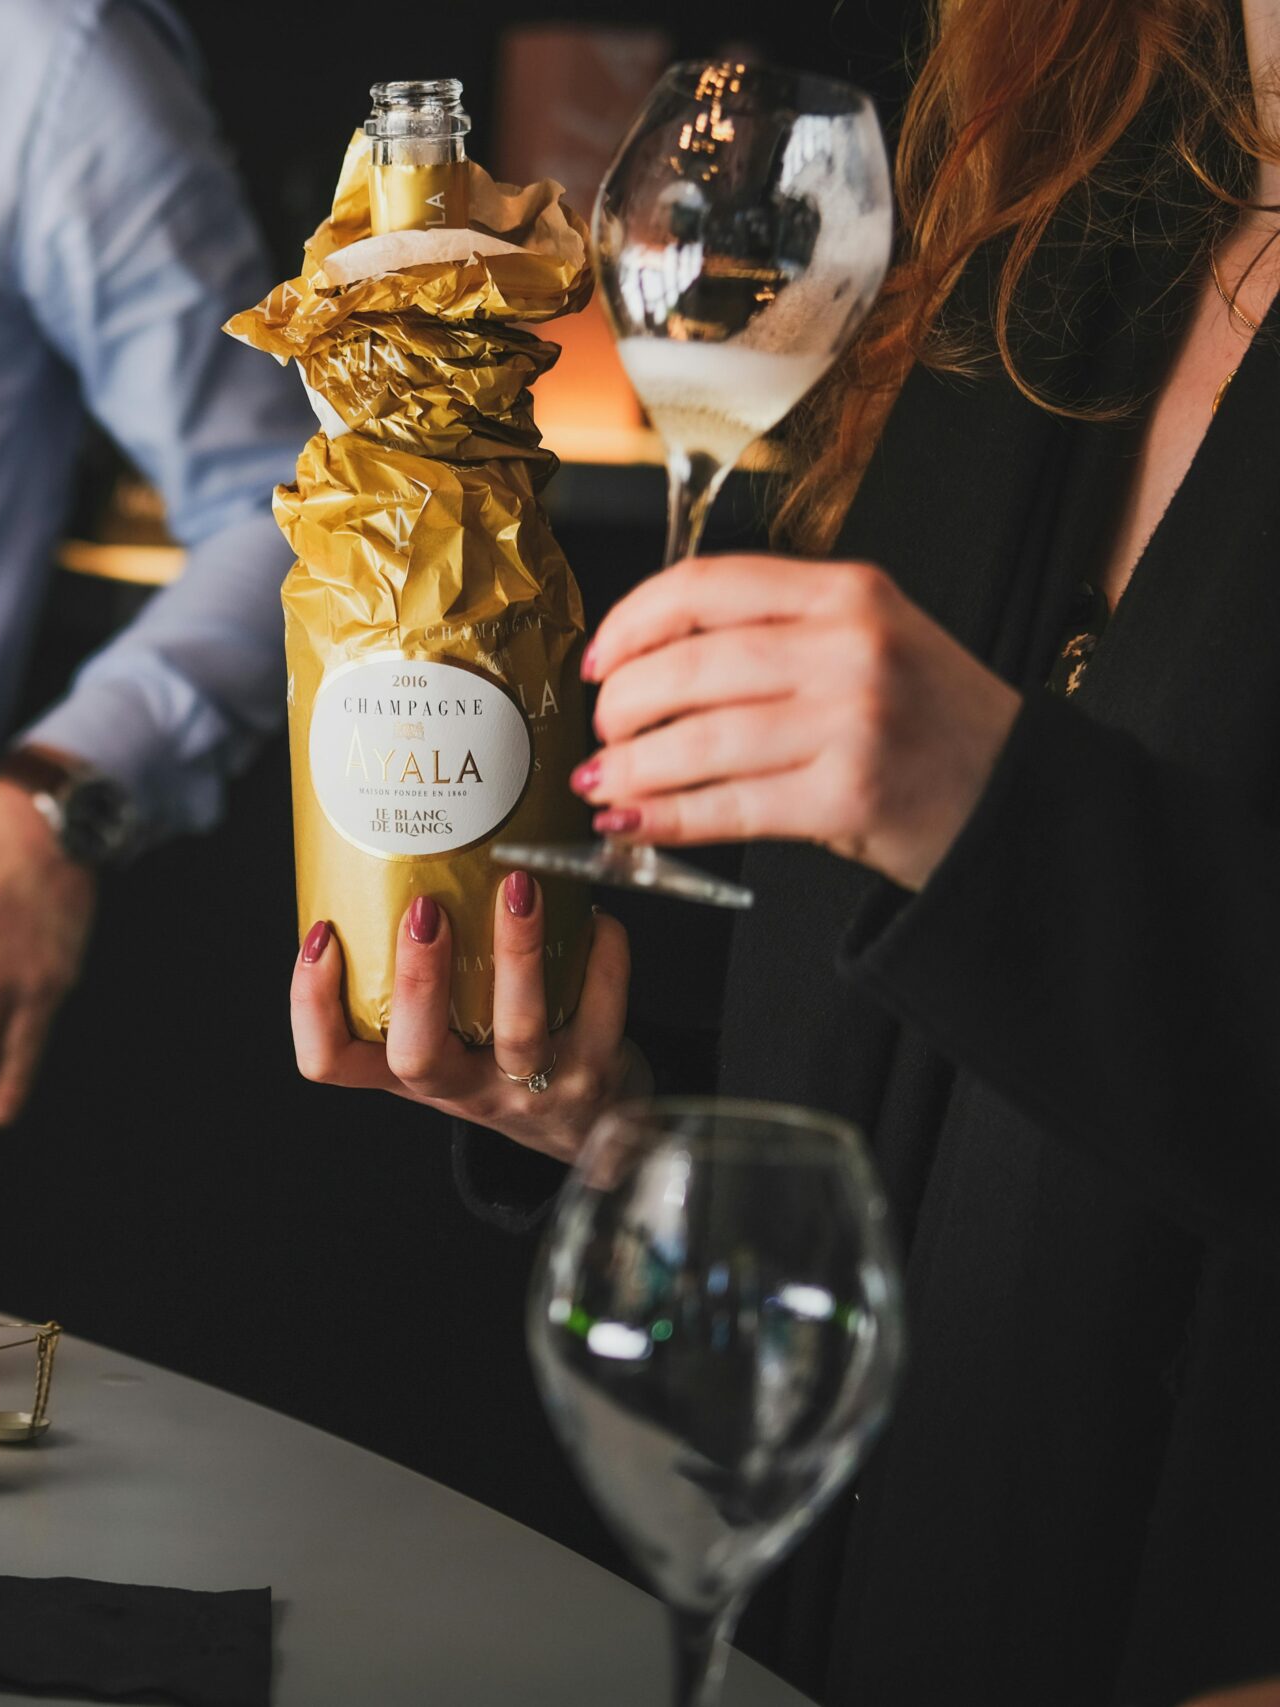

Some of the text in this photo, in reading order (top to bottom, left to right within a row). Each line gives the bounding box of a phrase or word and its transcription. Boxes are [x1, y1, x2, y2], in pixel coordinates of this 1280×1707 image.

[392, 675, 428, 688] 2016
[344, 697, 483, 716] CHAMPAGNE
[344, 722, 484, 784] AYALA
[359, 787, 390, 796] MAISON
[376, 808, 448, 822] LE BLANC
[370, 820, 453, 837] DE BLANCS
